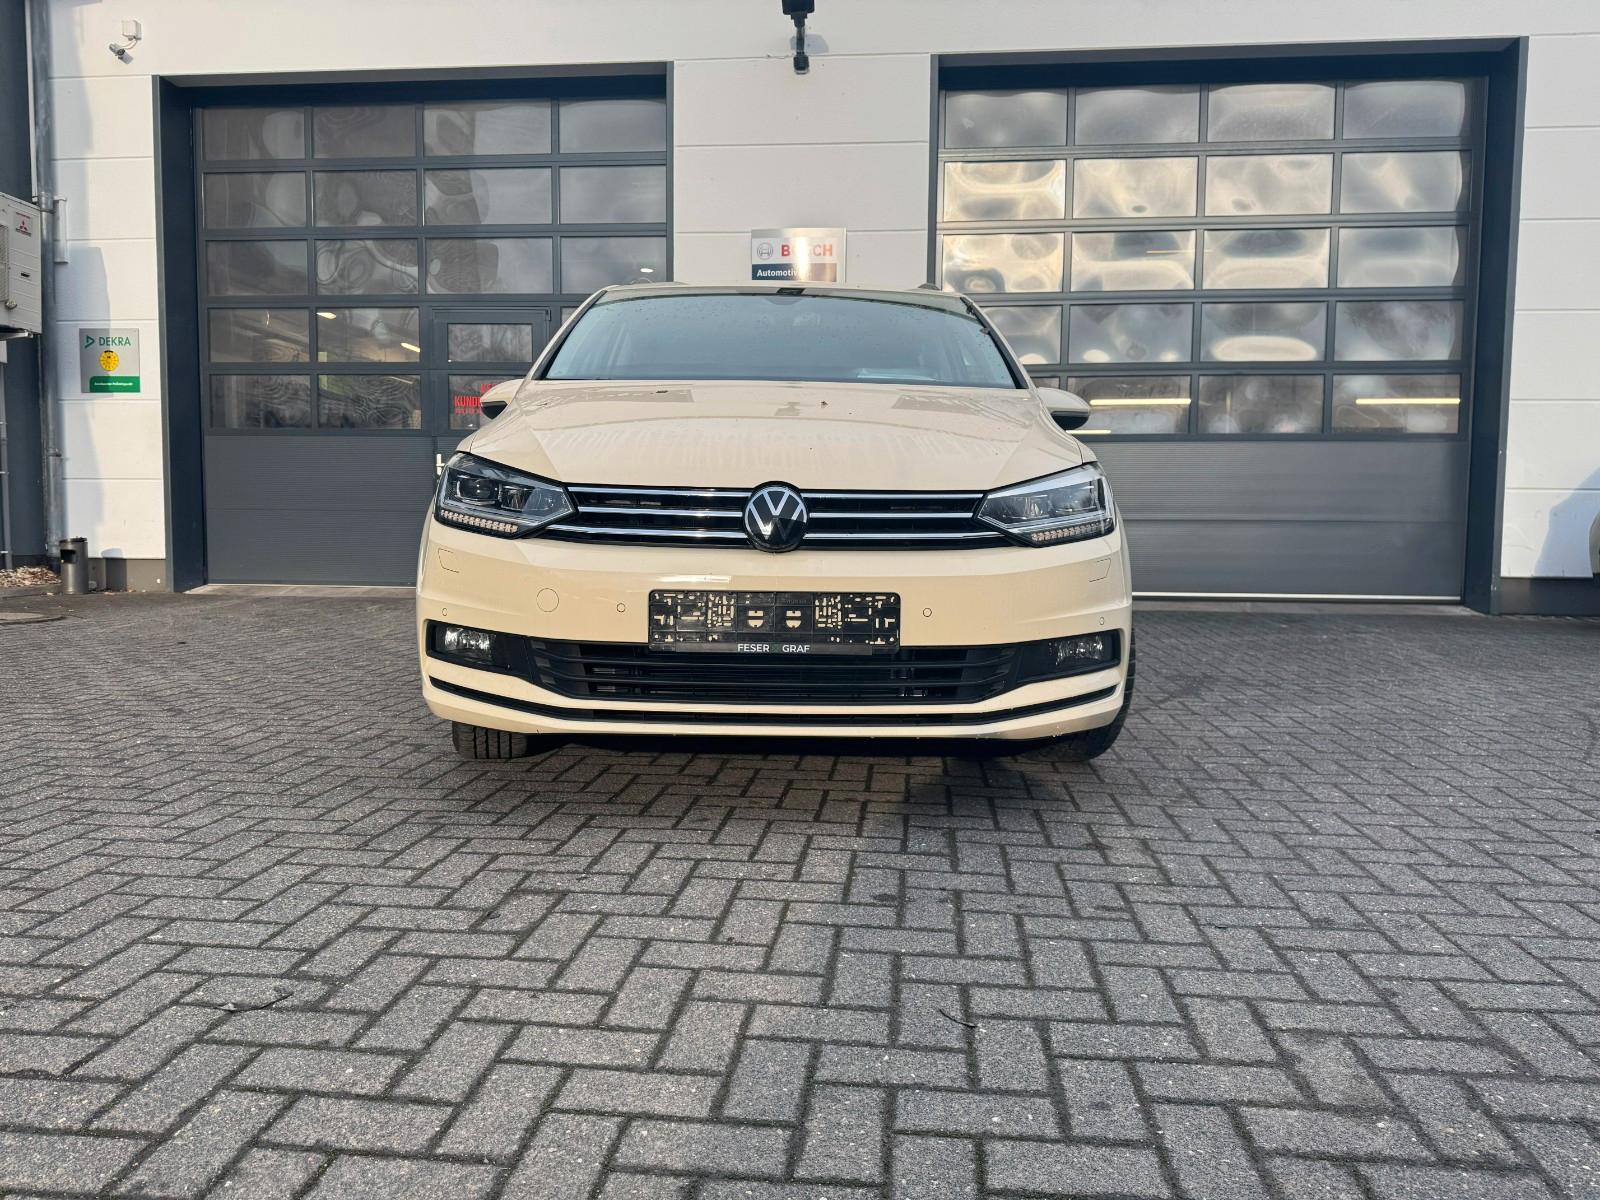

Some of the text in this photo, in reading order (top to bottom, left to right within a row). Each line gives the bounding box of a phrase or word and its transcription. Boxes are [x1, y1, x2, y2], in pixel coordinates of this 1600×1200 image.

[781, 243, 833, 257] BCH
[756, 269, 801, 277] Automotiv
[98, 336, 131, 346] DEKRA
[737, 643, 811, 653] FESER GRAF
